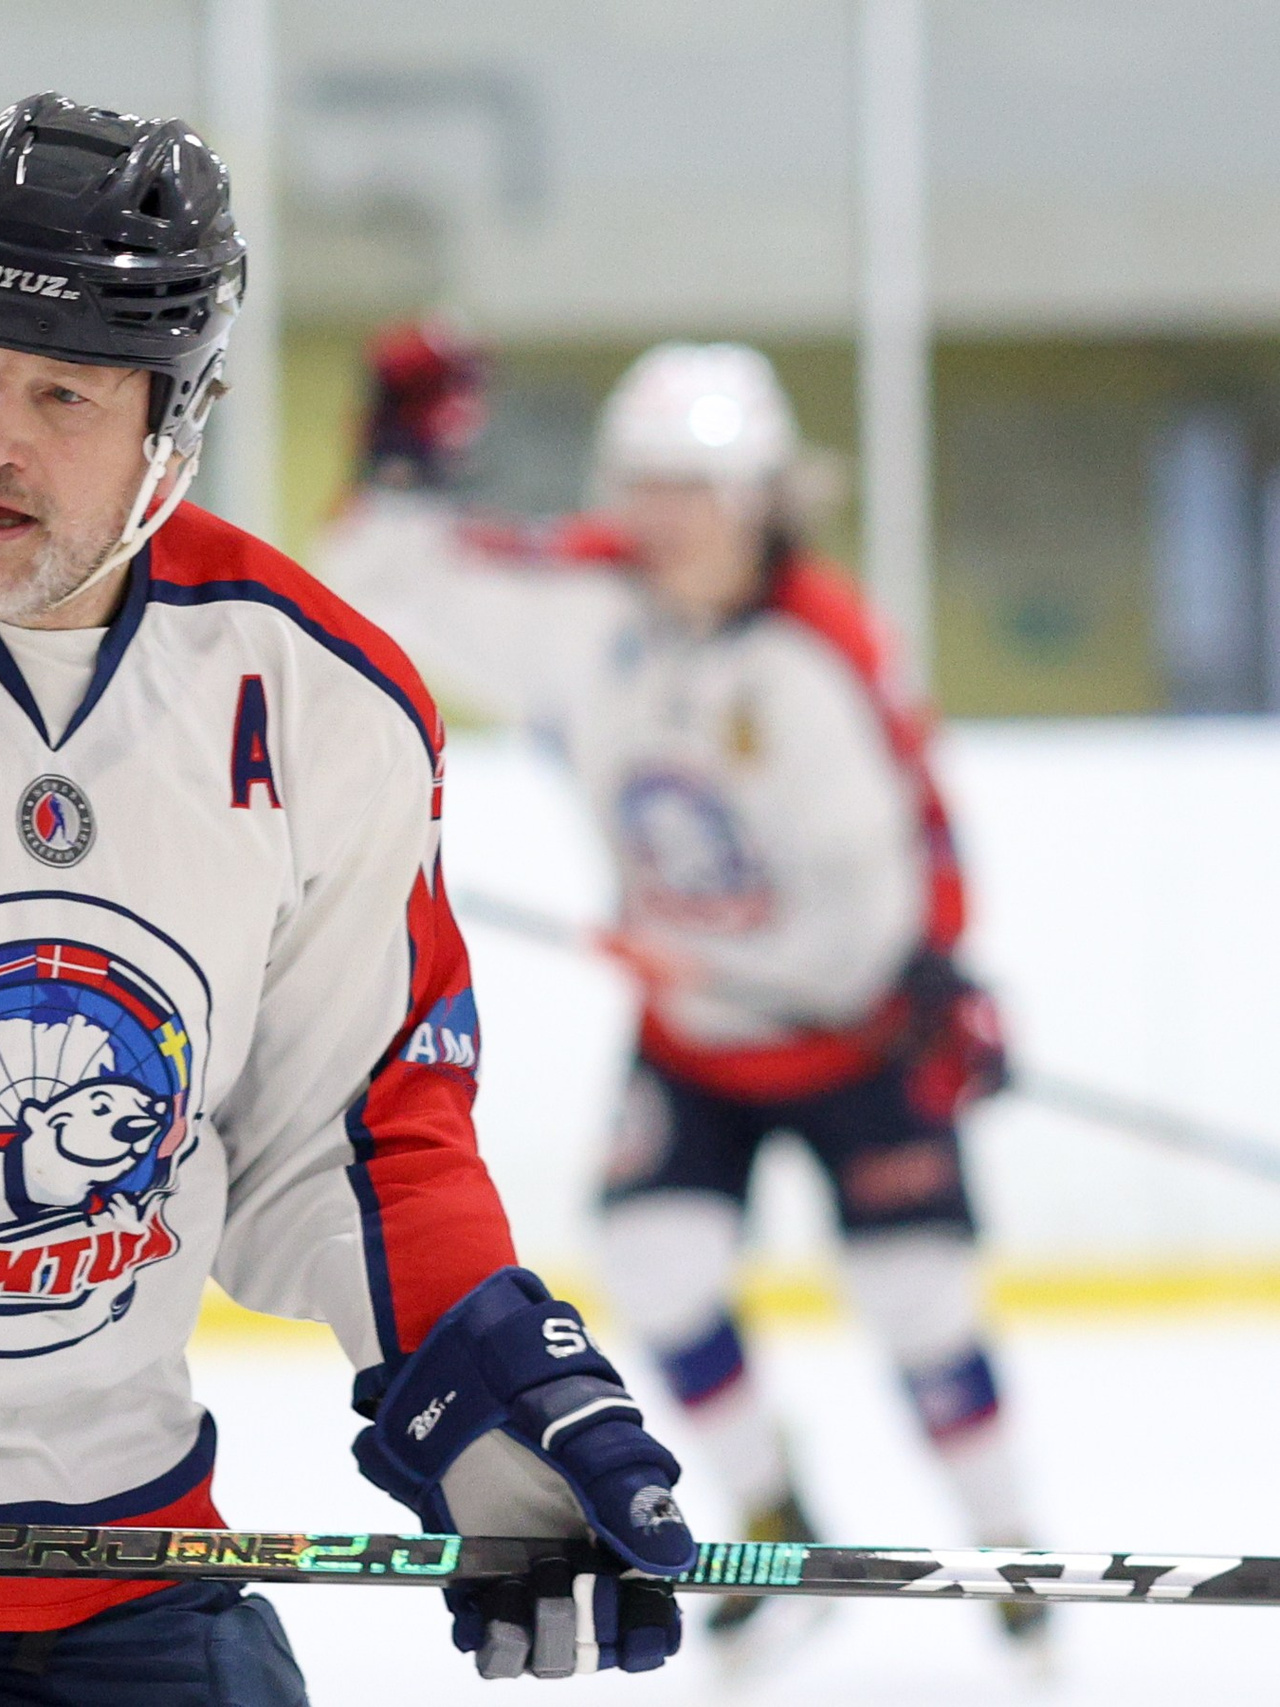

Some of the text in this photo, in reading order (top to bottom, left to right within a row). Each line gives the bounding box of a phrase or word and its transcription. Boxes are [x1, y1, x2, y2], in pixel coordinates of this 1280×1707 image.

[230, 674, 283, 809] A
[168, 1534, 302, 1565] ONE
[296, 1533, 462, 1575] 2.0
[875, 1550, 1244, 1599] X17
